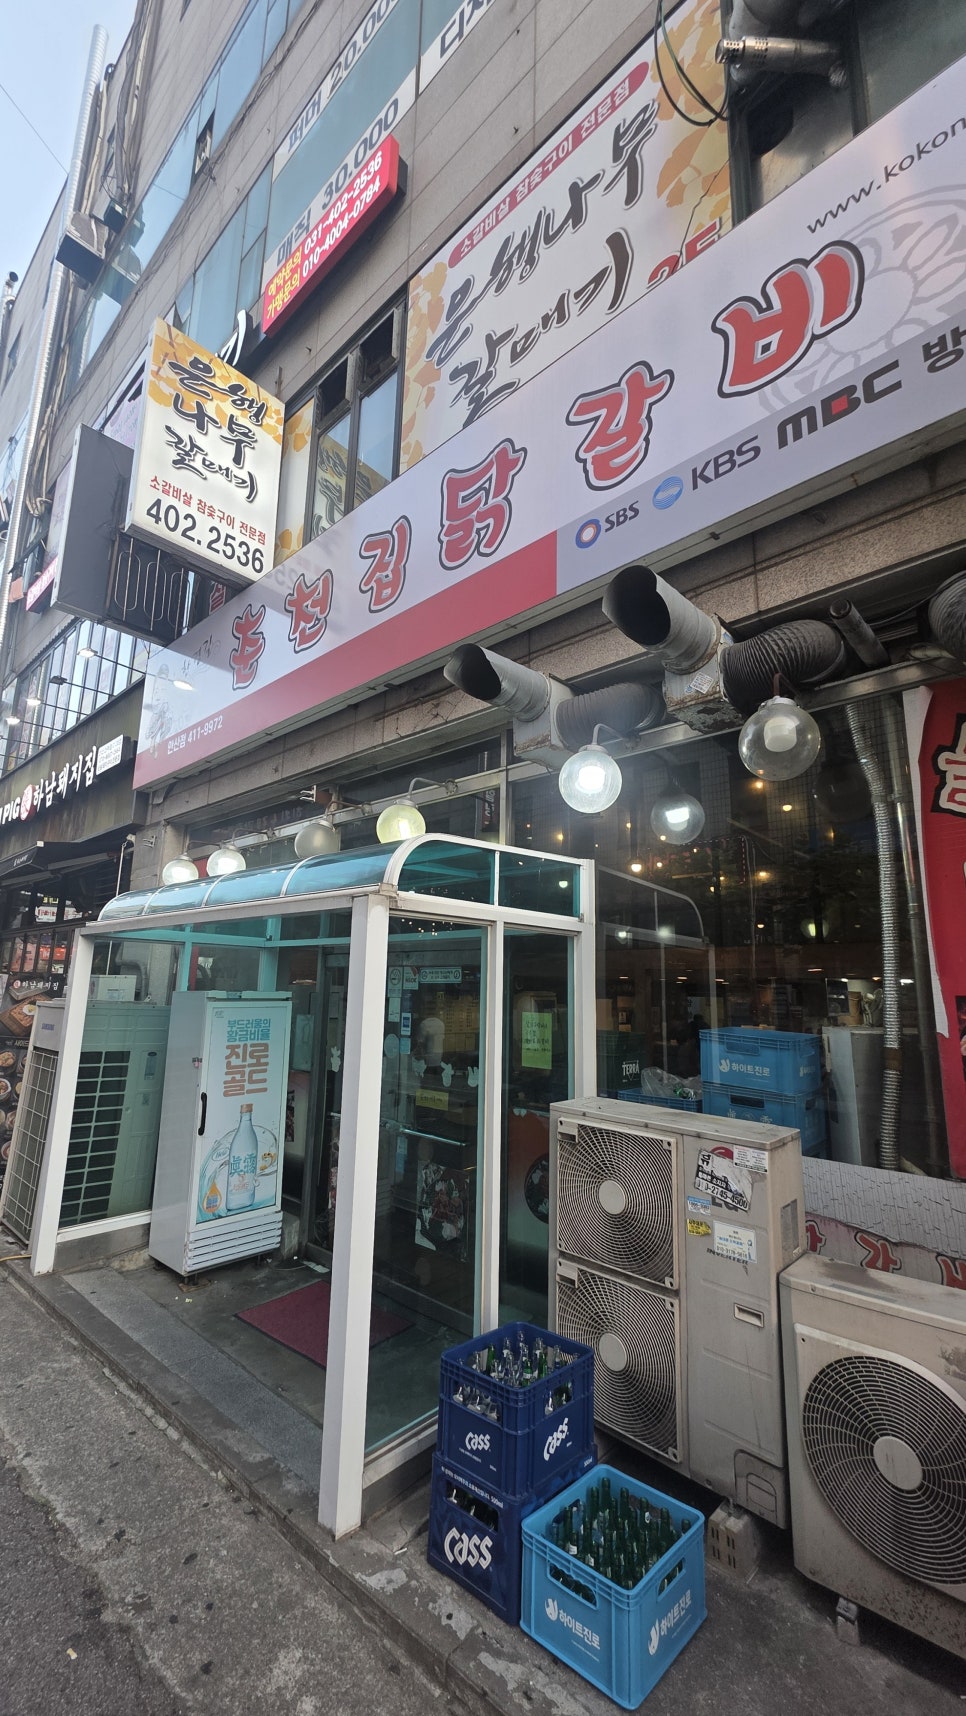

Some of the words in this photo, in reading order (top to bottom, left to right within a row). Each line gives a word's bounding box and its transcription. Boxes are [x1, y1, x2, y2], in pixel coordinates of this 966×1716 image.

[288, 90, 322, 154] 퍼머
[327, 0, 396, 100] 20.00
[277, 207, 312, 267] 매직
[322, 98, 399, 211] 30.000
[460, 199, 510, 258] 소갈비살
[580, 78, 631, 138] 전문점
[267, 270, 300, 320] 가맹문의
[303, 174, 381, 278] 010-4004-0784
[268, 250, 301, 297] 예약문의
[304, 150, 383, 255] 031-402-2536
[425, 99, 659, 370] 은행나무
[449, 228, 634, 428] 갈매기
[168, 356, 267, 425] 은행
[777, 359, 902, 449] MBC
[165, 424, 259, 503] 갈매기
[173, 392, 257, 468] 나무
[692, 436, 761, 491] KBS
[146, 498, 265, 574] 402.2536
[150, 475, 193, 508] 소갈비살
[197, 498, 236, 531] 참숯구이
[239, 520, 267, 547] 전문점
[604, 500, 640, 533] SBS
[167, 737, 188, 755] 안산점
[188, 715, 224, 743] 411-9972
[33, 745, 97, 813] 하남돼지집
[225, 1043, 269, 1071] 진로
[227, 1018, 271, 1029] 부드러움의
[227, 1028, 271, 1042] 황금비율
[223, 1067, 268, 1097] 골드
[622, 1060, 640, 1076] TERRA
[731, 1062, 771, 1077] 하이트진로
[559, 1608, 601, 1650] 하이트진로
[660, 1589, 692, 1637] 하이트진로
